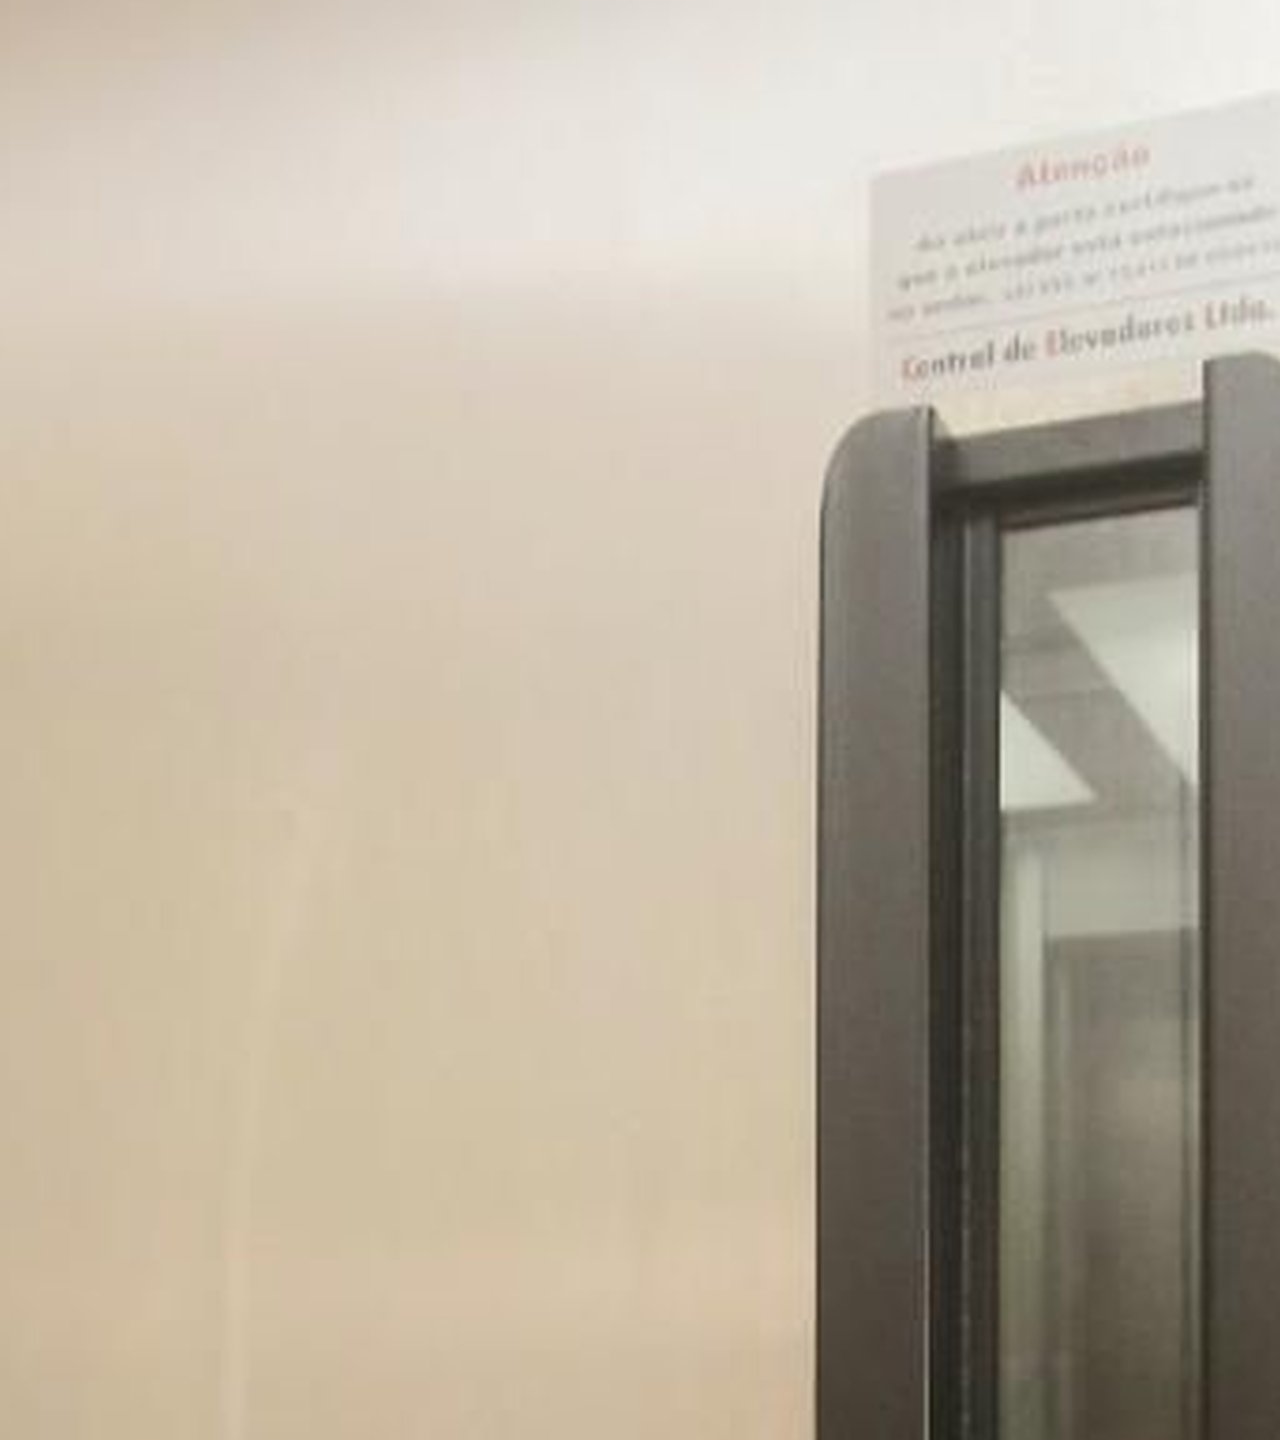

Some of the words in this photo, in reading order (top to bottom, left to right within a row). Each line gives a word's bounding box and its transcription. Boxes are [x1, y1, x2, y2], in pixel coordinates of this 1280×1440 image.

[1016, 140, 1151, 190] Atenção
[902, 341, 994, 381] Central
[1004, 333, 1037, 362] de
[1045, 313, 1196, 358] Elevadores
